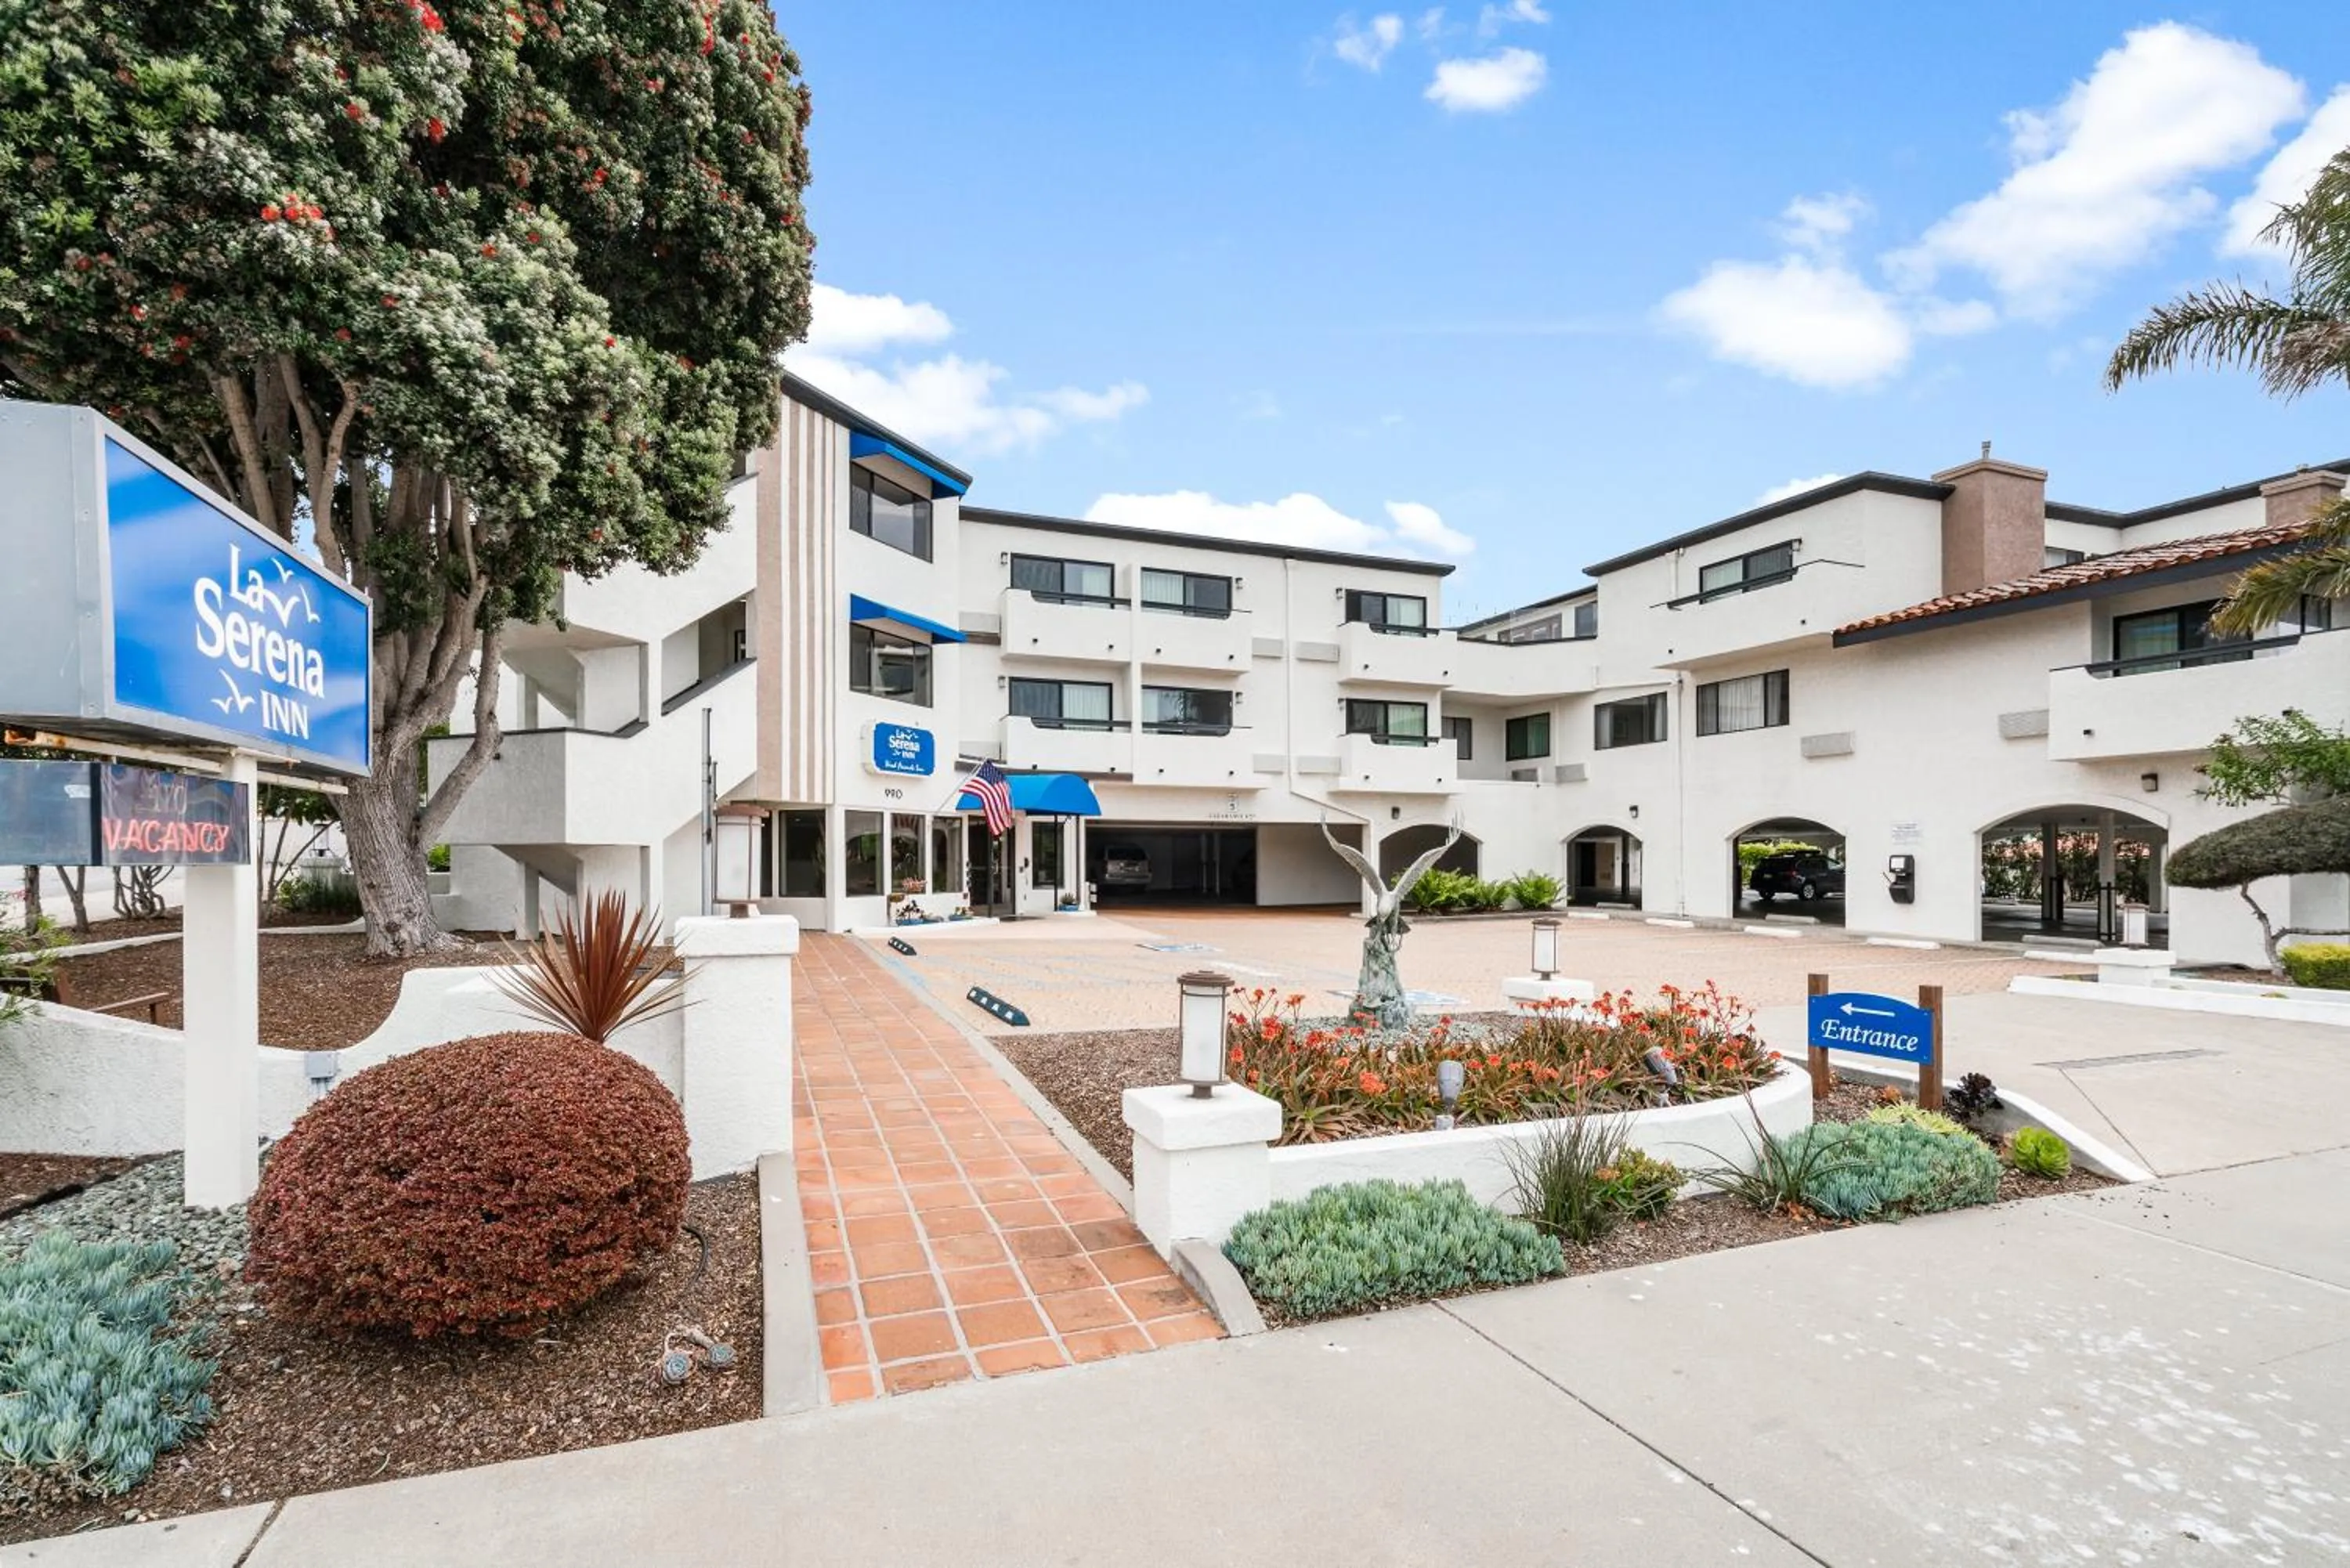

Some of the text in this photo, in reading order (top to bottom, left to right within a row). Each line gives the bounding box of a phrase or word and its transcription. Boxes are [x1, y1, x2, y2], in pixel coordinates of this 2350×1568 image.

[229, 543, 266, 614] La
[193, 576, 325, 699] Serena
[260, 688, 309, 740] INN
[888, 735, 920, 753] Serena
[102, 817, 230, 853] VACANCY
[1820, 1018, 1918, 1052] Entrance
